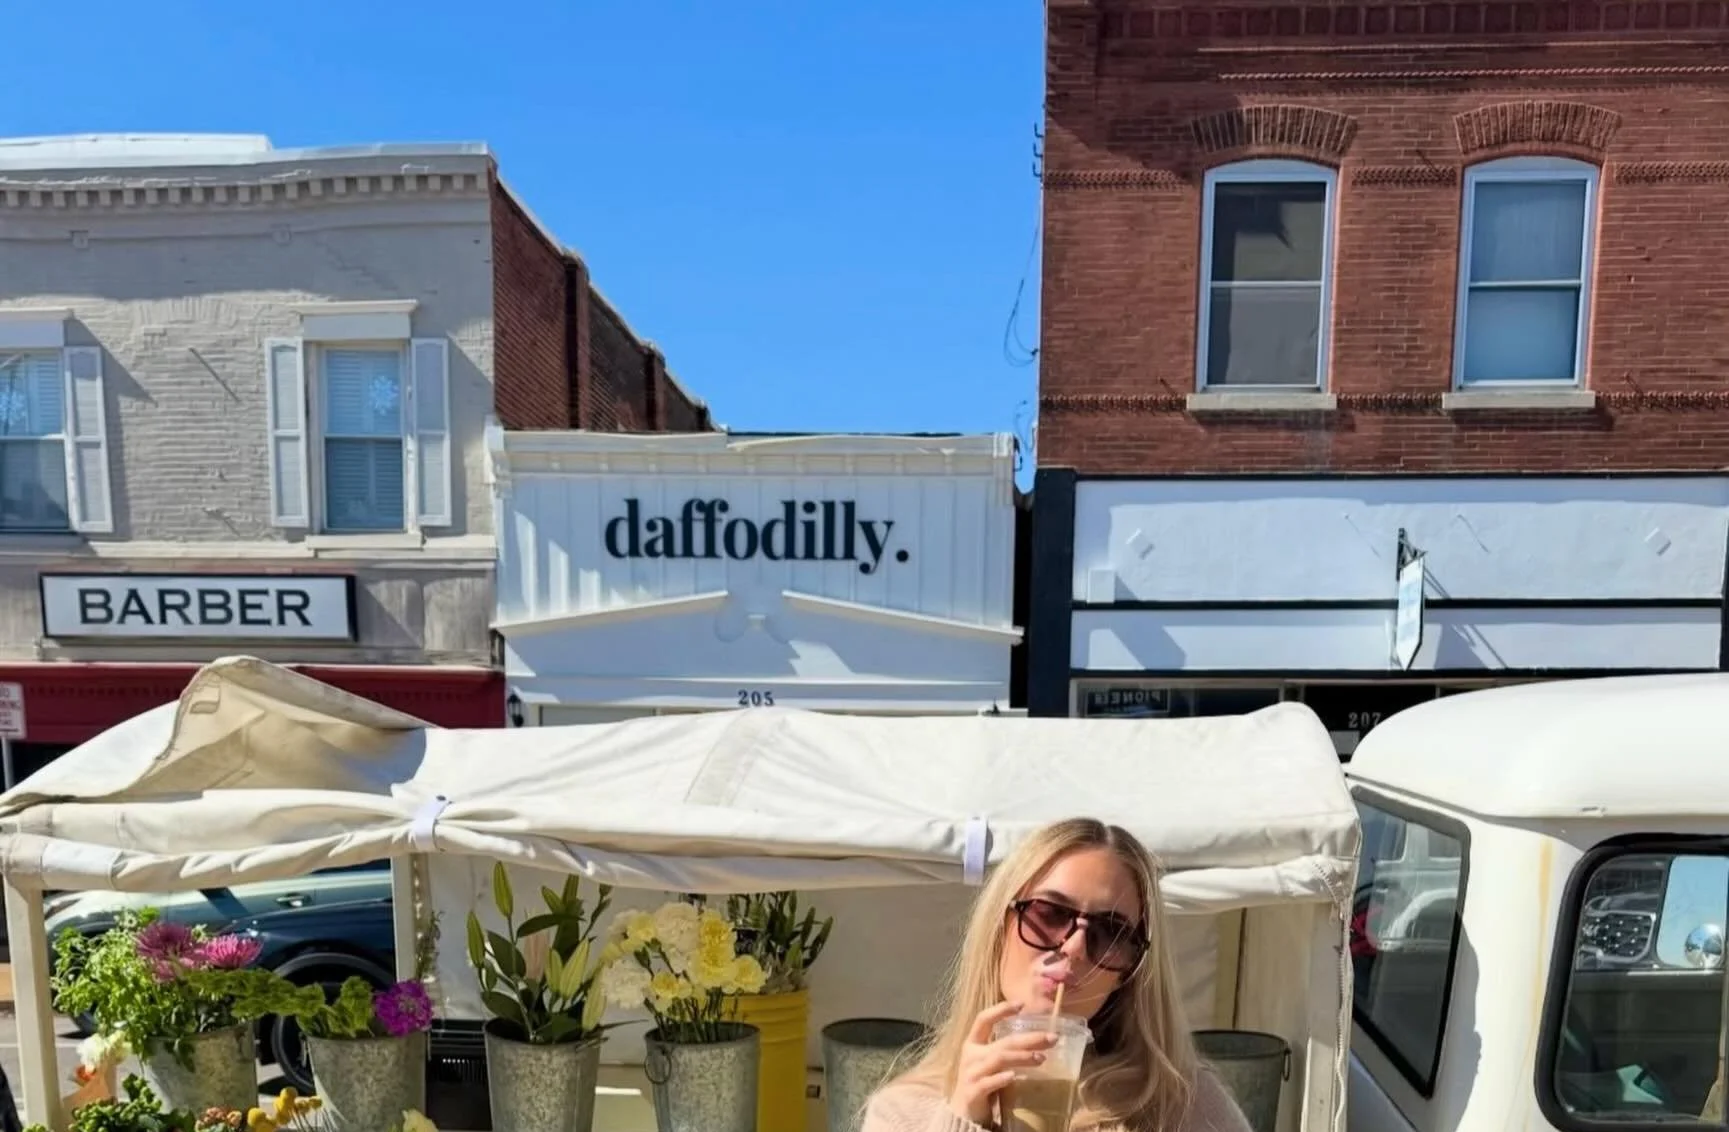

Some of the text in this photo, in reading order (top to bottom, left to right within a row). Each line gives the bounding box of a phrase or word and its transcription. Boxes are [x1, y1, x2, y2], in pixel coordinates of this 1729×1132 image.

[605, 498, 911, 575] daffodilly.
[78, 587, 313, 627] BARBER
[738, 690, 774, 706] 205
[1348, 711, 1382, 729] 207
